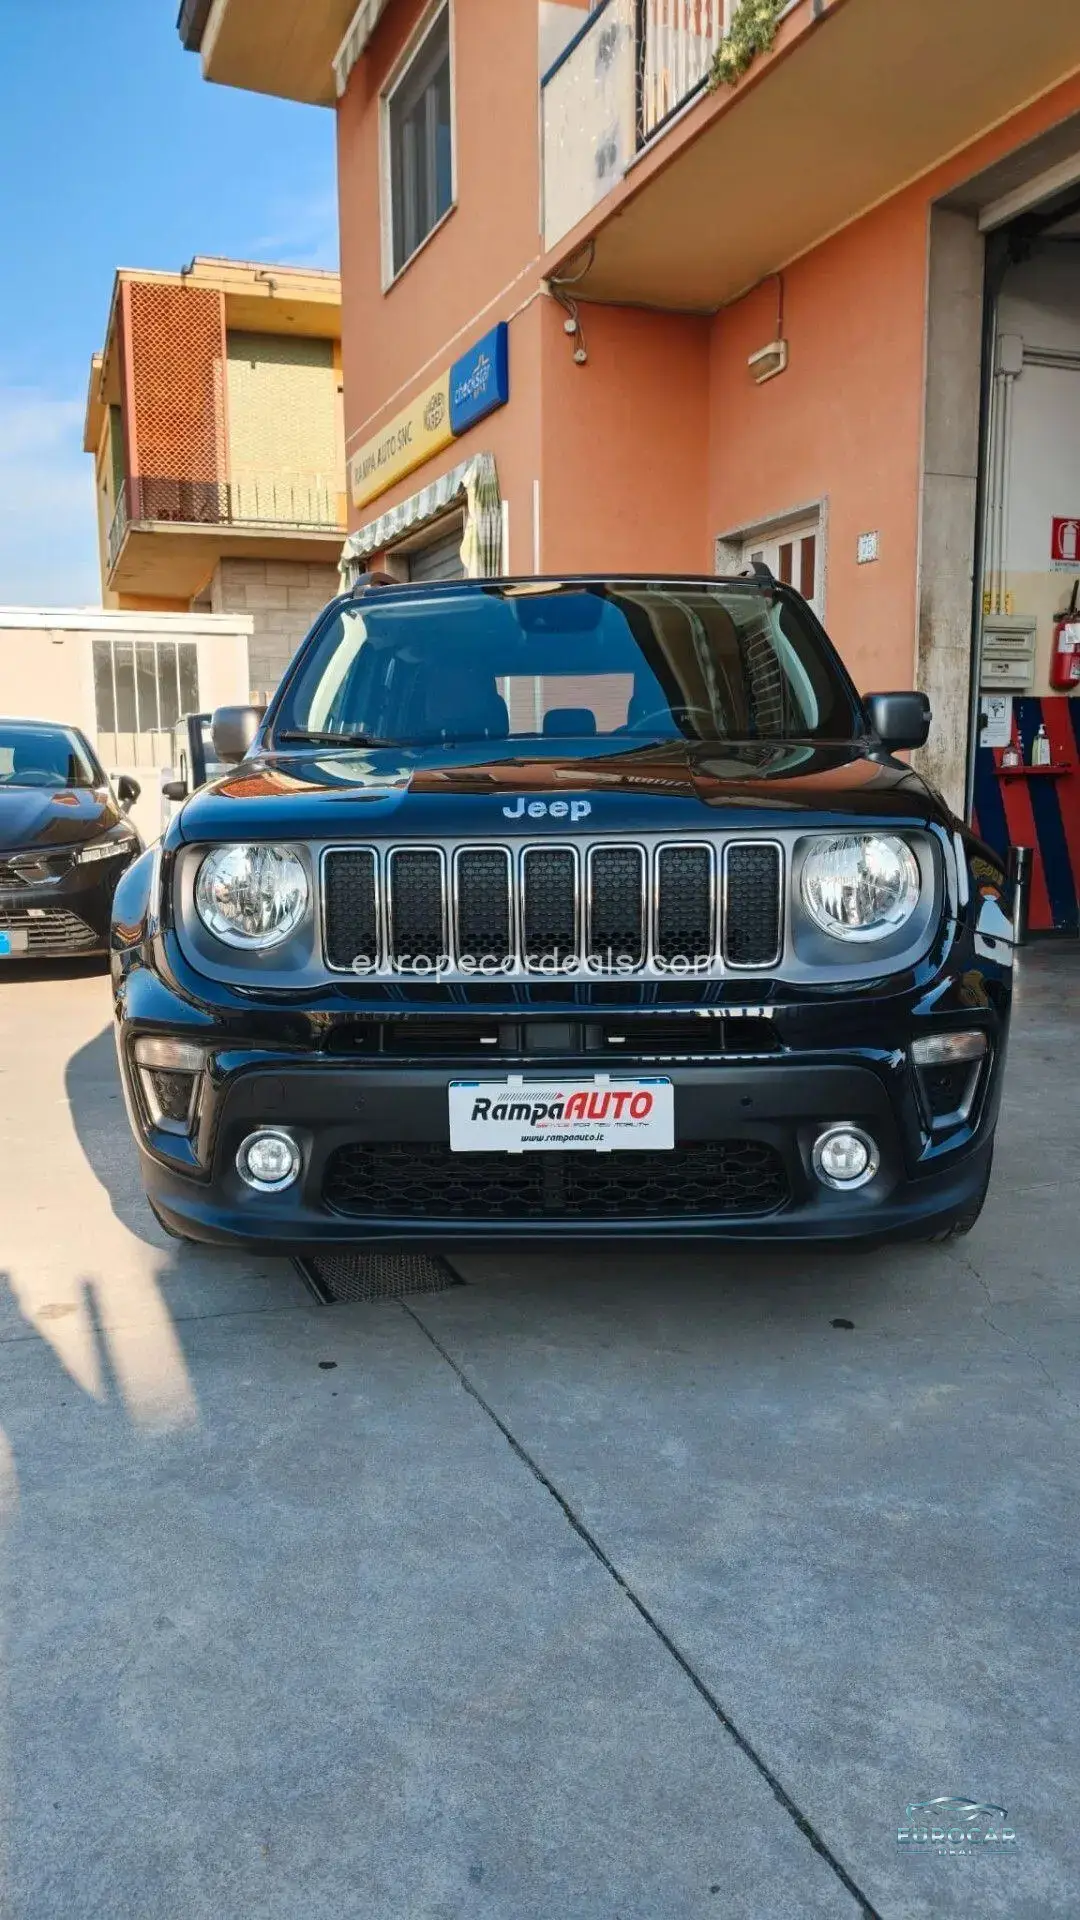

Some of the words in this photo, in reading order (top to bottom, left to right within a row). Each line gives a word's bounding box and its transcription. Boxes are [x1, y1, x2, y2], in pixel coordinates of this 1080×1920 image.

[355, 452, 376, 484] RAMPA
[377, 435, 396, 467] AUTO
[397, 420, 413, 450] SNC
[503, 798, 592, 821] Jeep
[521, 1132, 605, 1143] www.rampaauto.it
